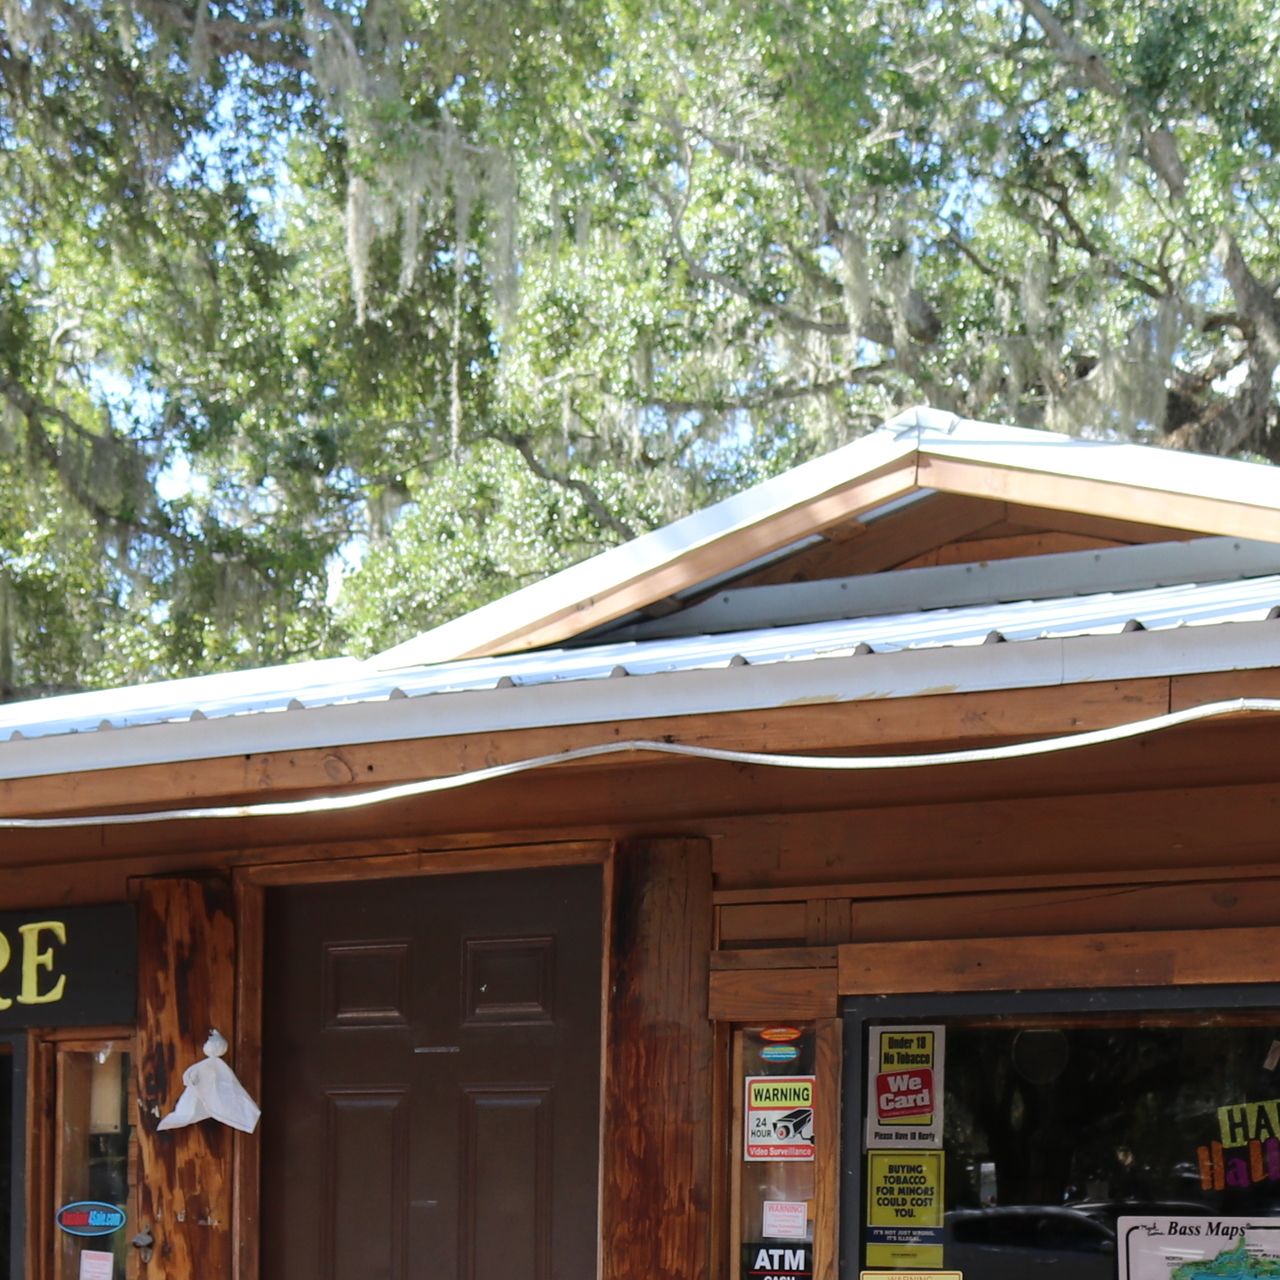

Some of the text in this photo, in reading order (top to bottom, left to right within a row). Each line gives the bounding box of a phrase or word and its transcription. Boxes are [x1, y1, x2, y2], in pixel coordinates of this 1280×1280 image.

[888, 1036, 926, 1049] Under 18
[883, 1052, 931, 1065] No Tobacco
[887, 1074, 922, 1093] We
[753, 1087, 810, 1103] WARNING
[880, 1088, 931, 1111] Card
[755, 1117, 767, 1128] 24
[751, 1129, 772, 1138] HOUR
[749, 1146, 812, 1156] Video Surveillance
[888, 1164, 923, 1174] BUYING
[883, 1175, 927, 1185] TOBACCO
[876, 1186, 935, 1197] FOR MINORS
[876, 1197, 934, 1208] COULD COST
[767, 1204, 803, 1214] WARNING
[894, 1208, 917, 1218] YOU.
[1167, 1221, 1202, 1236] Bass
[1205, 1221, 1247, 1241] Maps
[753, 1248, 805, 1271] ATM
